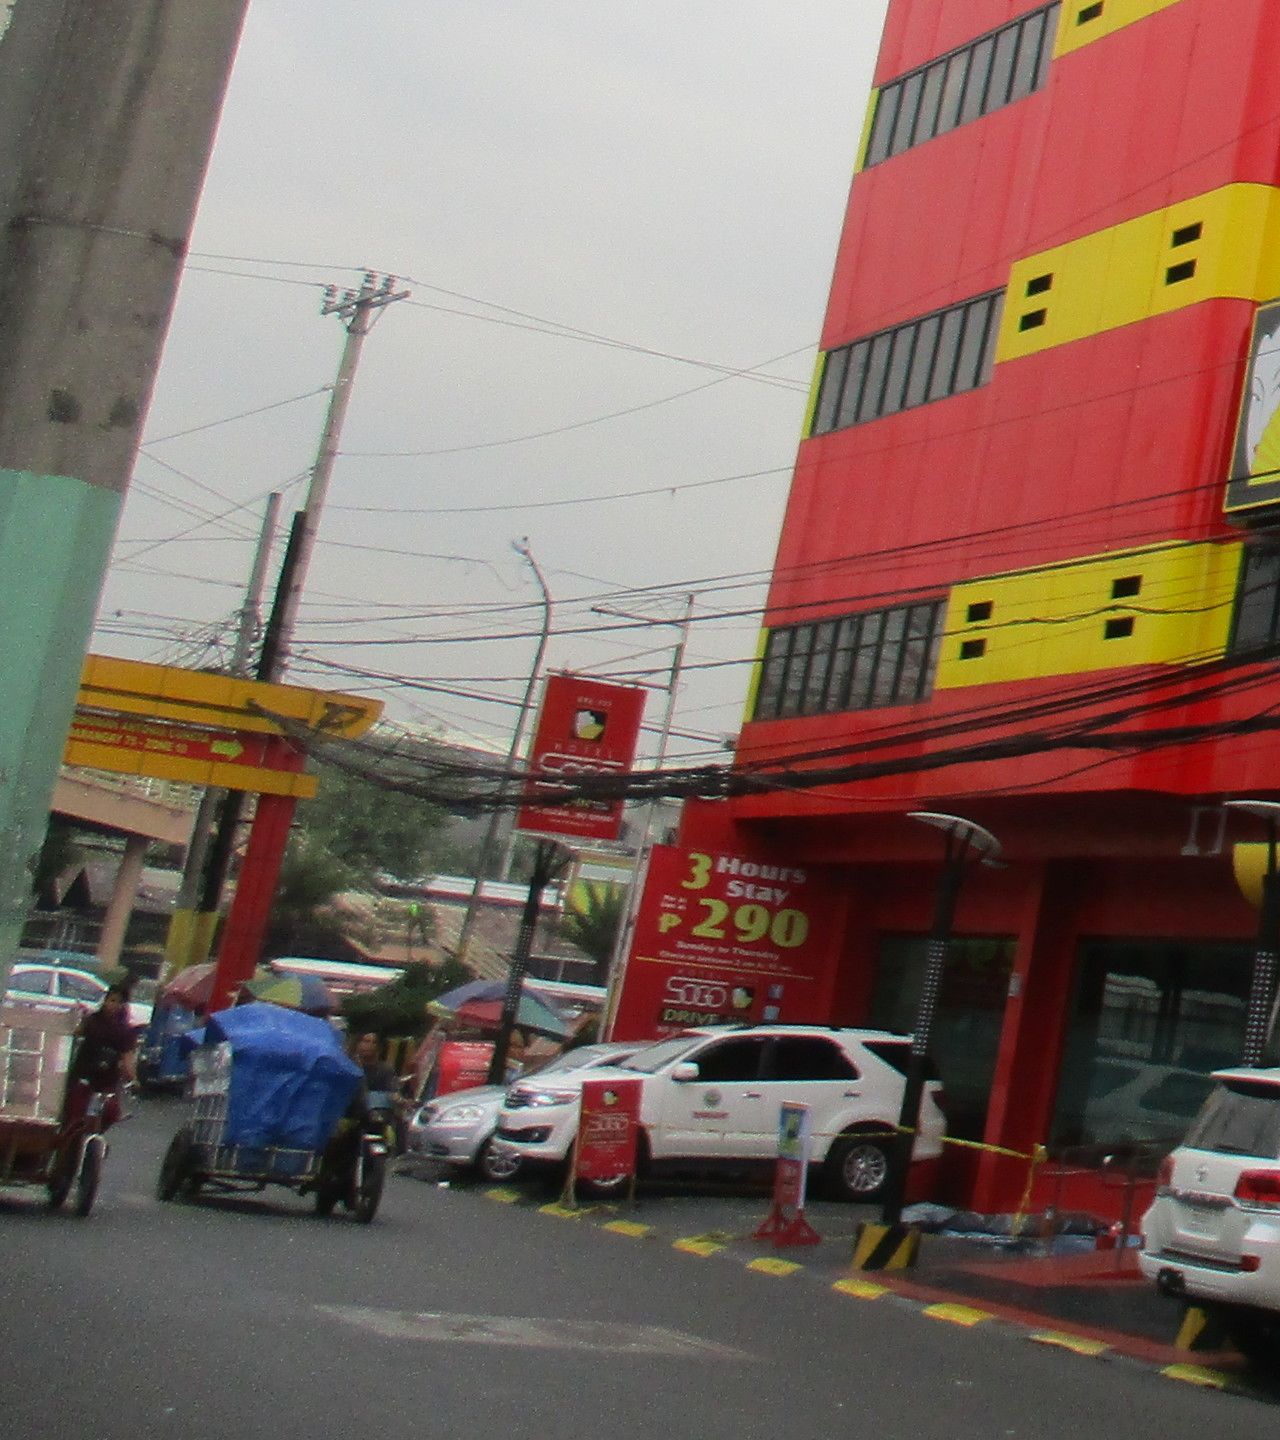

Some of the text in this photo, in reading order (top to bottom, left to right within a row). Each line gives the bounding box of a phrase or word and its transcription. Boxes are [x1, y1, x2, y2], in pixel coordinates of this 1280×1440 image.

[681, 853, 807, 890] 3 Hours
[726, 880, 790, 905] Stay
[691, 898, 809, 948] 290
[663, 976, 730, 1008] SOGO
